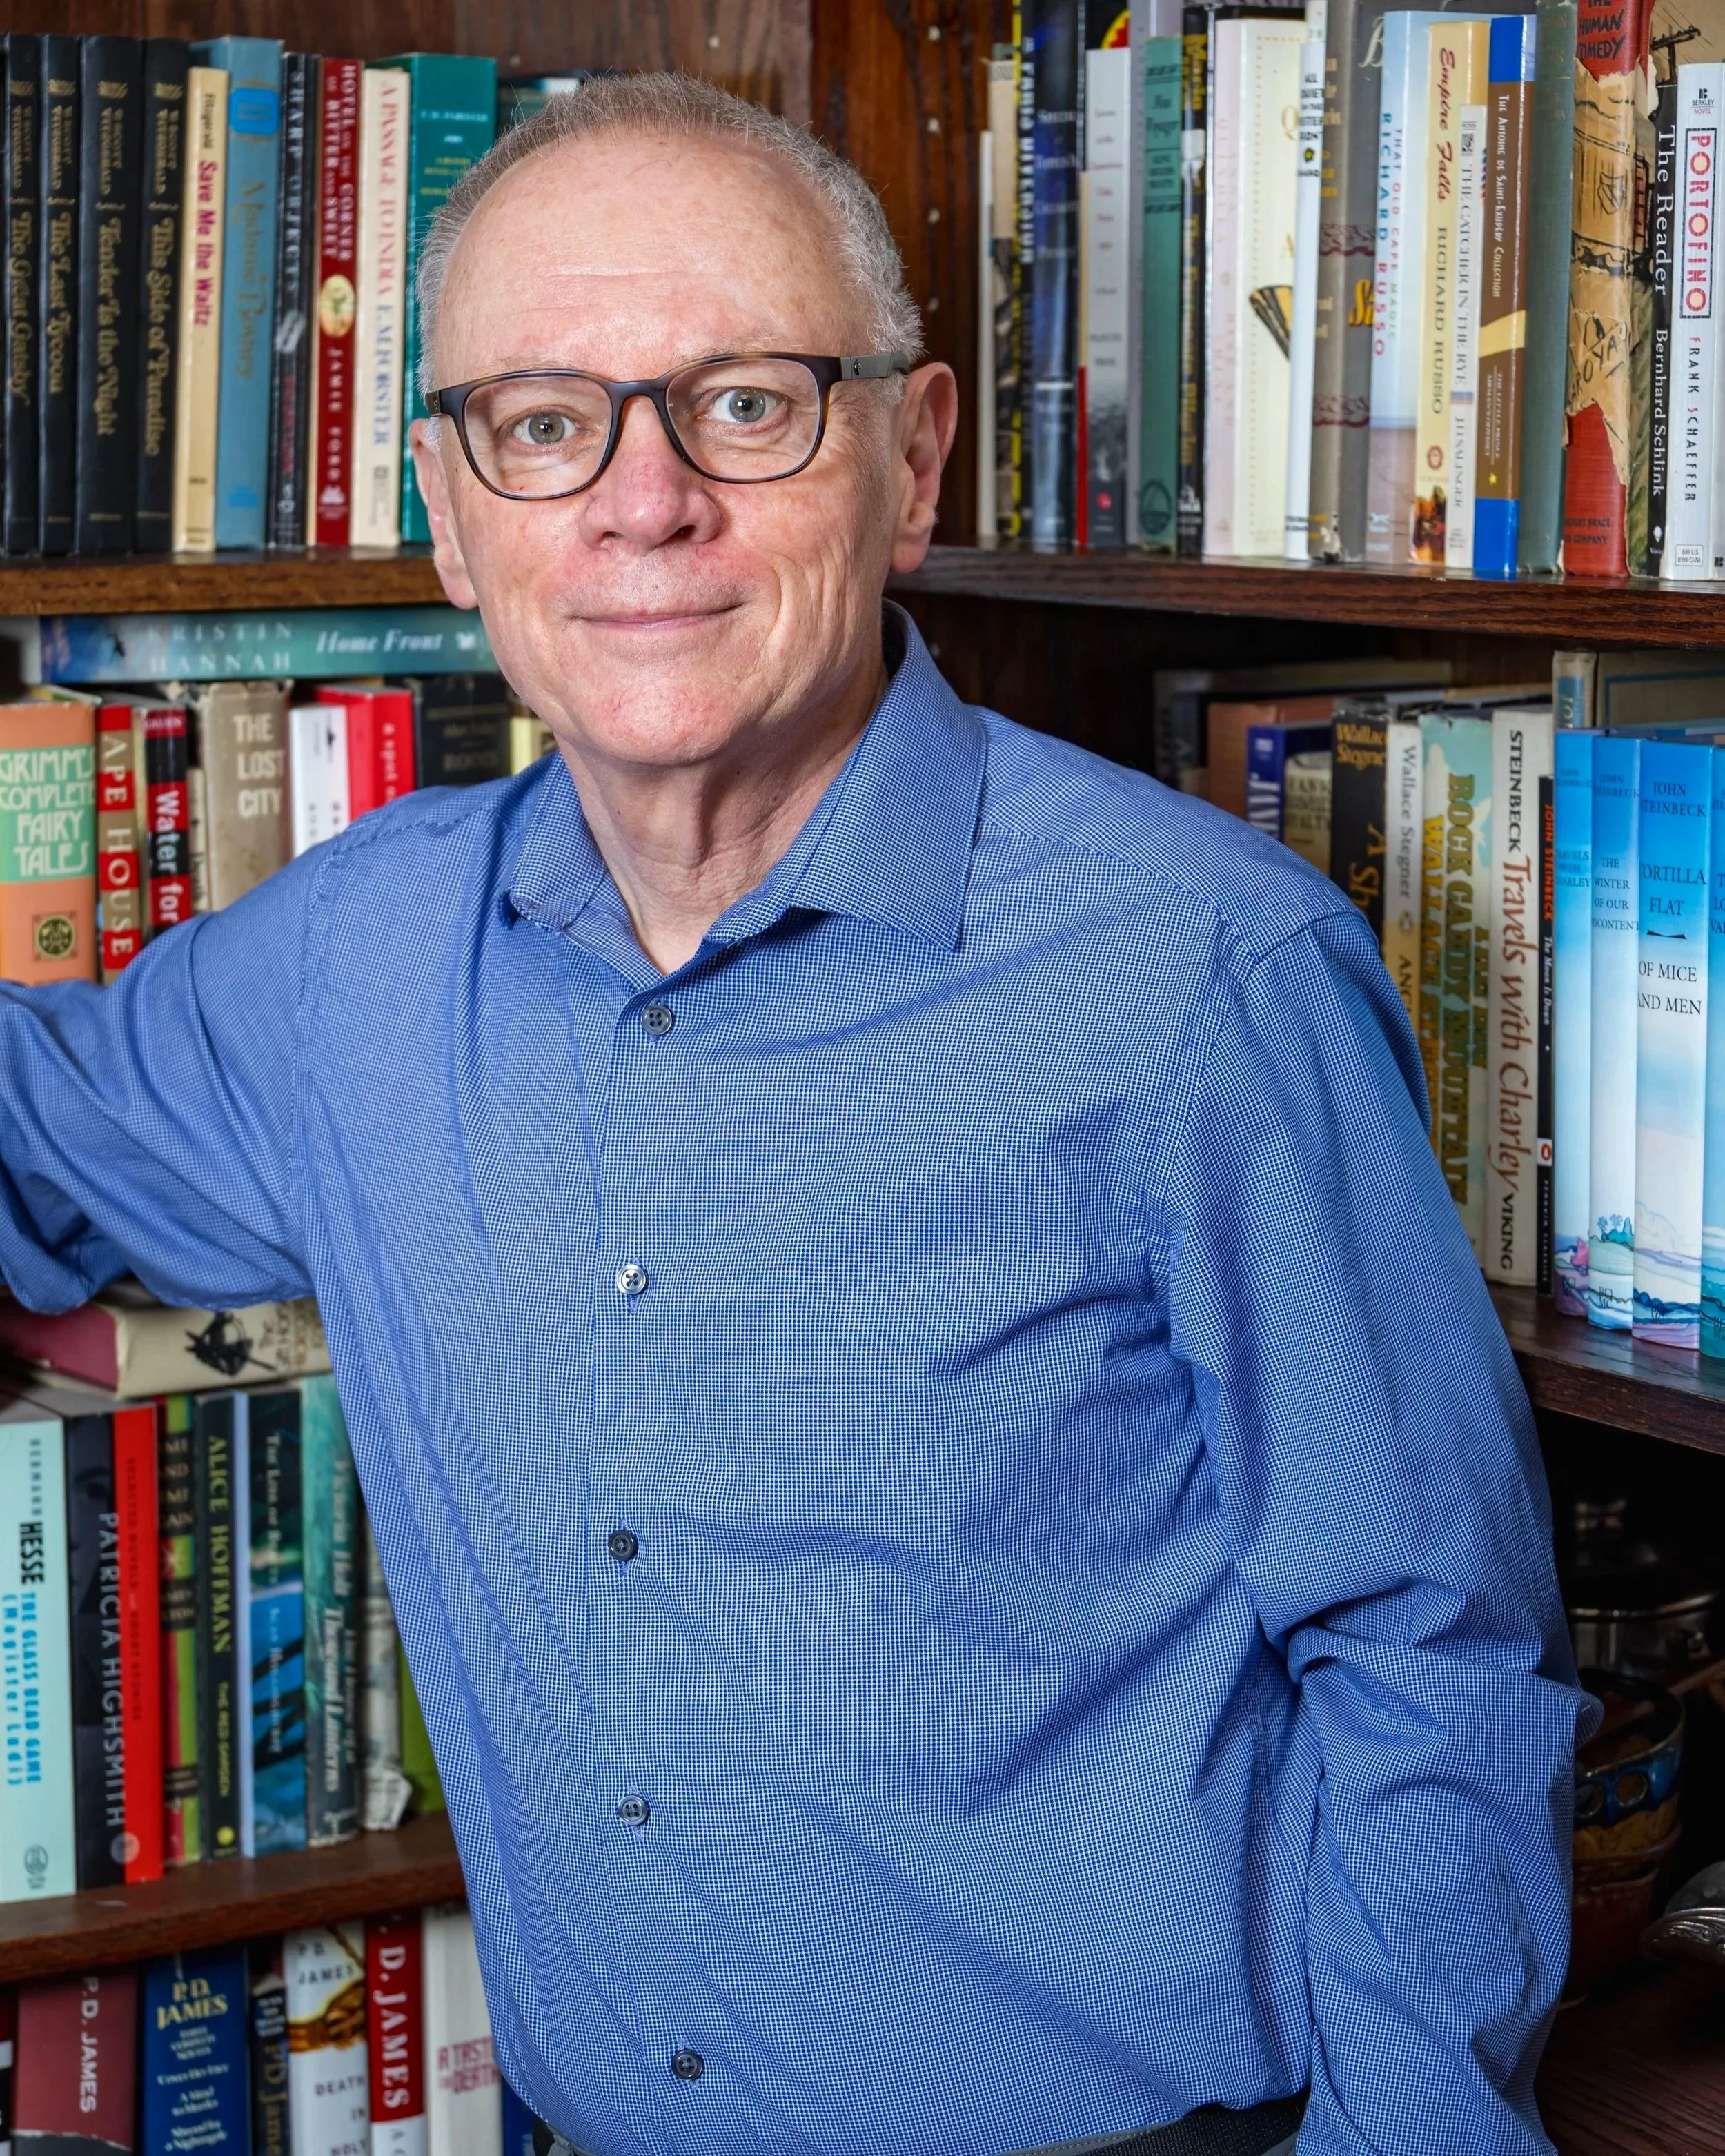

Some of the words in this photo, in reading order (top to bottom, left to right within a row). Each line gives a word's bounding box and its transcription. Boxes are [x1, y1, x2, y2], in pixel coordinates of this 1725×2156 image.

[289, 72, 305, 159] SHARP
[340, 65, 357, 126] HOTEL
[1437, 47, 1455, 131] Empire
[324, 99, 341, 168] BITTER
[380, 103, 398, 186] PASSAGE
[1394, 129, 1403, 170] THAT
[1657, 124, 1676, 183] The
[198, 161, 217, 203] Save
[1377, 112, 1392, 241] RICHARD
[1392, 182, 1401, 215] OLD
[1436, 141, 1453, 204] Falls
[1460, 164, 1472, 200] THE
[12, 212, 32, 255] The
[49, 212, 71, 256] The
[150, 217, 174, 268] This
[197, 210, 215, 235] Me
[284, 175, 302, 293] OBJECTS
[323, 197, 339, 257] SWEET
[337, 183, 354, 261] CORNER
[1183, 214, 1199, 257] The
[1390, 227, 1400, 270] CAPE
[1458, 204, 1472, 285] CATCHER
[1654, 193, 1675, 295] Reader
[1685, 134, 1711, 312] PORTOFINO
[49, 256, 71, 309] Last
[97, 217, 122, 299] Tender
[195, 243, 214, 270] the
[1432, 226, 1447, 332] RICHARD
[1492, 246, 1505, 298] COLLECTION
[8, 257, 32, 318] Great
[97, 299, 120, 327] Is
[146, 270, 172, 324] Side
[193, 278, 214, 326] Waltz
[1373, 261, 1388, 355] RUSSO
[1388, 282, 1399, 340] MAGIC
[1457, 289, 1469, 309] IN
[97, 329, 119, 366] the
[148, 326, 170, 357] of
[1181, 266, 1198, 375] Fortunate
[1455, 312, 1468, 346] THE
[8, 321, 32, 406] Gatsby
[47, 311, 71, 394] Tycoon
[327, 348, 343, 412] JAMIE
[1431, 340, 1445, 415] RUSSO
[1455, 352, 1467, 386] RYE
[1653, 328, 1669, 419] Bernhard
[1687, 337, 1701, 393] FRANK
[93, 365, 119, 435] Night
[144, 352, 170, 457] Paradise
[1179, 382, 1197, 466] Pilgrim
[327, 426, 342, 481] FORD
[1452, 438, 1464, 508] SALINGER
[1652, 424, 1666, 496] Schlink
[1684, 408, 1699, 502] SCHAEFFER
[1574, 535, 1606, 544] COMPANY
[148, 653, 291, 675] HANNAH
[315, 630, 379, 654] Home
[383, 628, 444, 652] Front
[233, 713, 274, 743] THE
[103, 735, 128, 805] APE
[237, 749, 285, 781] LOST
[1399, 746, 1417, 819] Wallace
[1508, 729, 1524, 853] STEINBECK
[1600, 774, 1625, 784] JOHN
[1652, 782, 1687, 797] JOHN
[17, 808, 84, 844] FAIRY
[155, 789, 181, 873] Water
[238, 787, 284, 819] CITY
[1446, 773, 1476, 876] ROCK
[1544, 803, 1555, 842] JOHN
[14, 840, 90, 878] TALES
[1396, 825, 1415, 899] Stegner
[1543, 847, 1555, 920] STEINBECK
[1594, 877, 1630, 890] WINTER
[1601, 857, 1620, 869] THE
[106, 828, 133, 956] HOUSE
[159, 884, 184, 922] for
[1421, 814, 1446, 986] WALLACE
[1502, 855, 1539, 965] Travels
[1594, 898, 1605, 909] OF
[1606, 899, 1629, 910] OUR
[1649, 898, 1685, 916] FLAT
[1442, 880, 1474, 1005] CANDY
[1543, 956, 1552, 984] Moon
[1544, 936, 1552, 954] The
[1543, 987, 1552, 997] Is
[1638, 960, 1655, 977] OF
[1658, 962, 1698, 982] MICE
[1542, 998, 1552, 1025] Down
[1664, 997, 1702, 1015] MEN
[1441, 1011, 1471, 1206] MOUNTAIN
[1487, 1062, 1533, 1191] Charley
[1501, 1193, 1515, 1271] VIKING
[208, 1435, 228, 1513] ALICE
[333, 1459, 349, 1545] Victoria
[19, 1521, 45, 1586] HESSE
[97, 1512, 122, 1649] PATRICIA
[20, 1592, 38, 1622] THE
[210, 1525, 231, 1654] HOFFMAN
[22, 1629, 39, 1681] GLASS
[324, 1608, 344, 1699] Thousand
[23, 1688, 40, 1730] BEAD
[217, 1682, 230, 1708] THE
[101, 1656, 126, 1826] HIGHSMITH
[218, 1710, 230, 1739] RED
[324, 1703, 344, 1792] Lanterns
[25, 1737, 41, 1783] GAME
[218, 1741, 230, 1797] GARDEN
[298, 1965, 355, 1986] JAMES
[379, 1944, 406, 1983] D.
[156, 1994, 228, 2030] JAMES
[79, 2032, 98, 2113] JAMES
[373, 1989, 411, 2109] JAMES
[437, 2046, 449, 2071] A
[315, 2076, 366, 2097] DEATH
